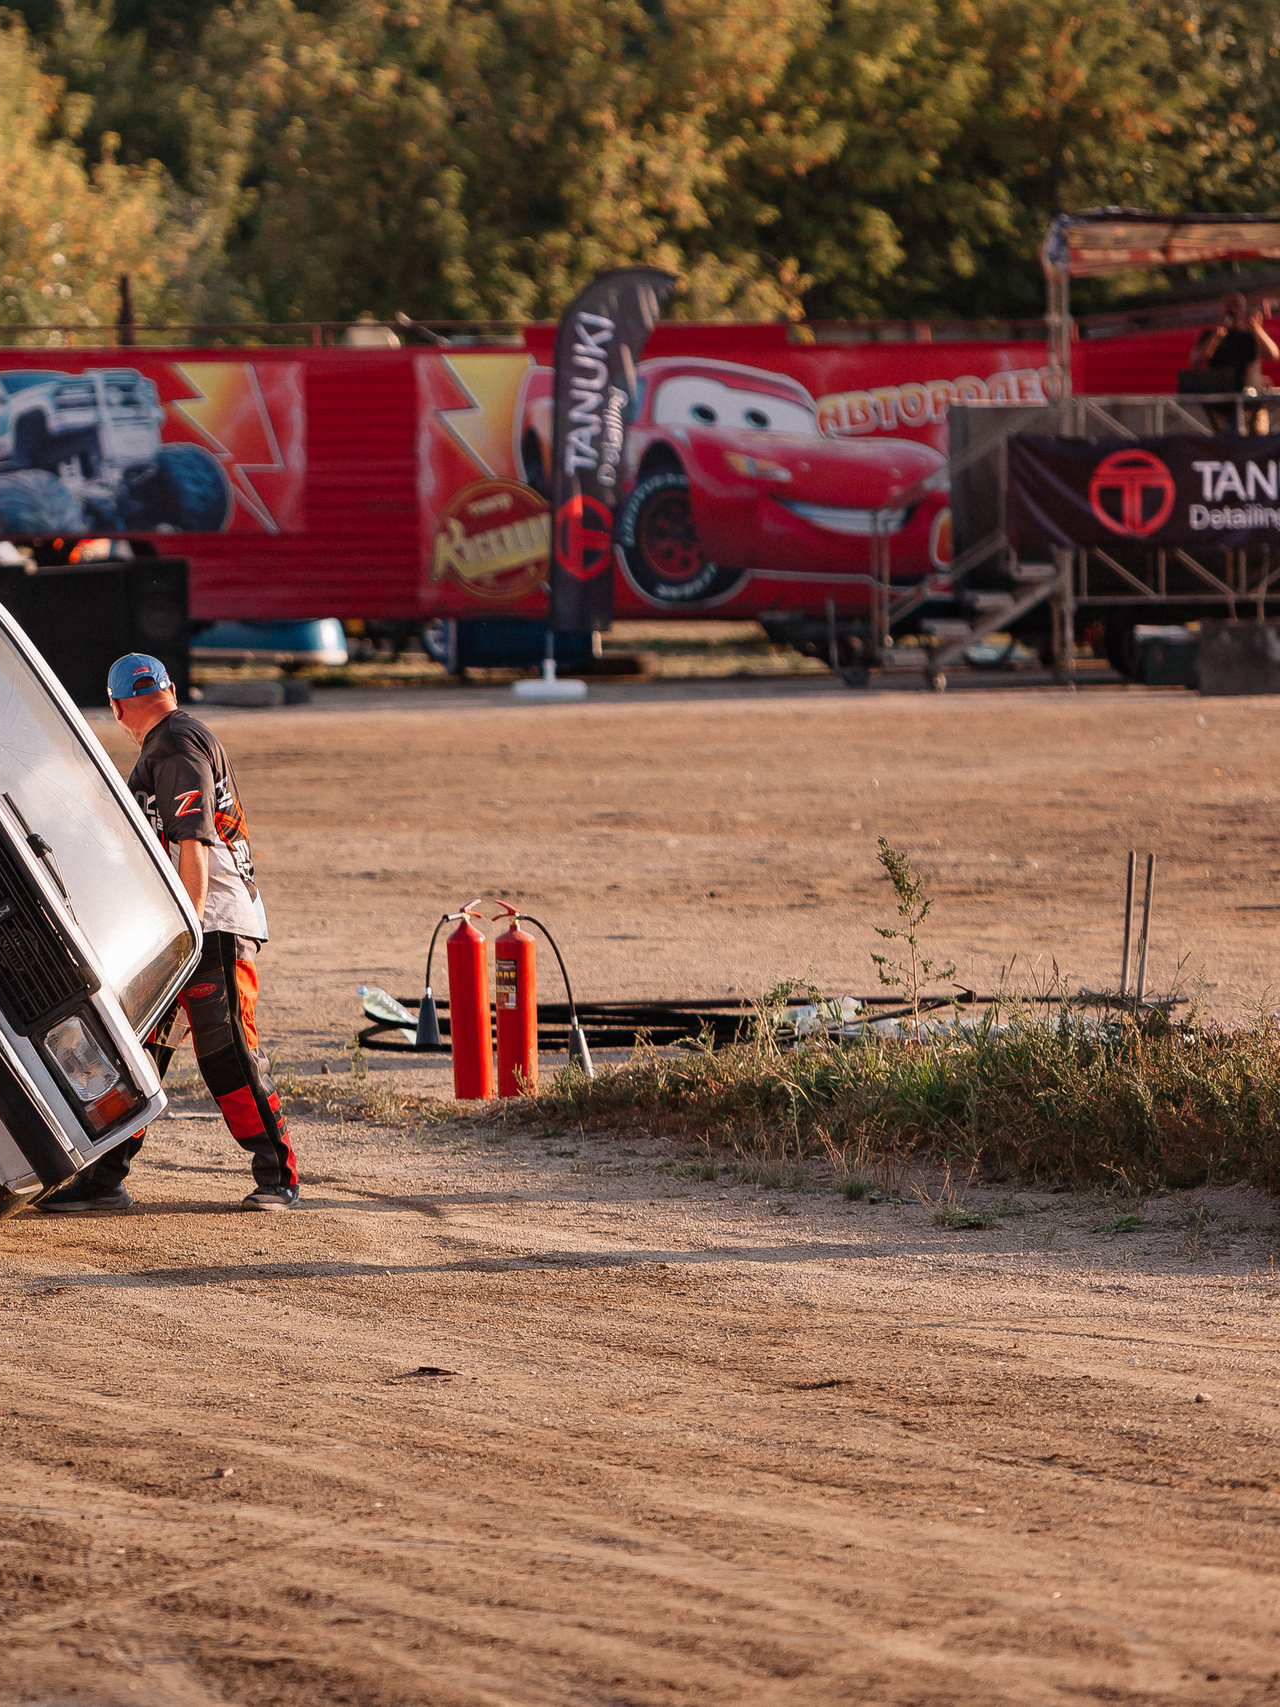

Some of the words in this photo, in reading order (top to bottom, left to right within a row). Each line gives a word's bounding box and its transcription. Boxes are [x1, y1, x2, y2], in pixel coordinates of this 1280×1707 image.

[564, 311, 616, 477] TANUKI
[1191, 460, 1280, 501] TAN
[188, 984, 216, 998] SPORT
